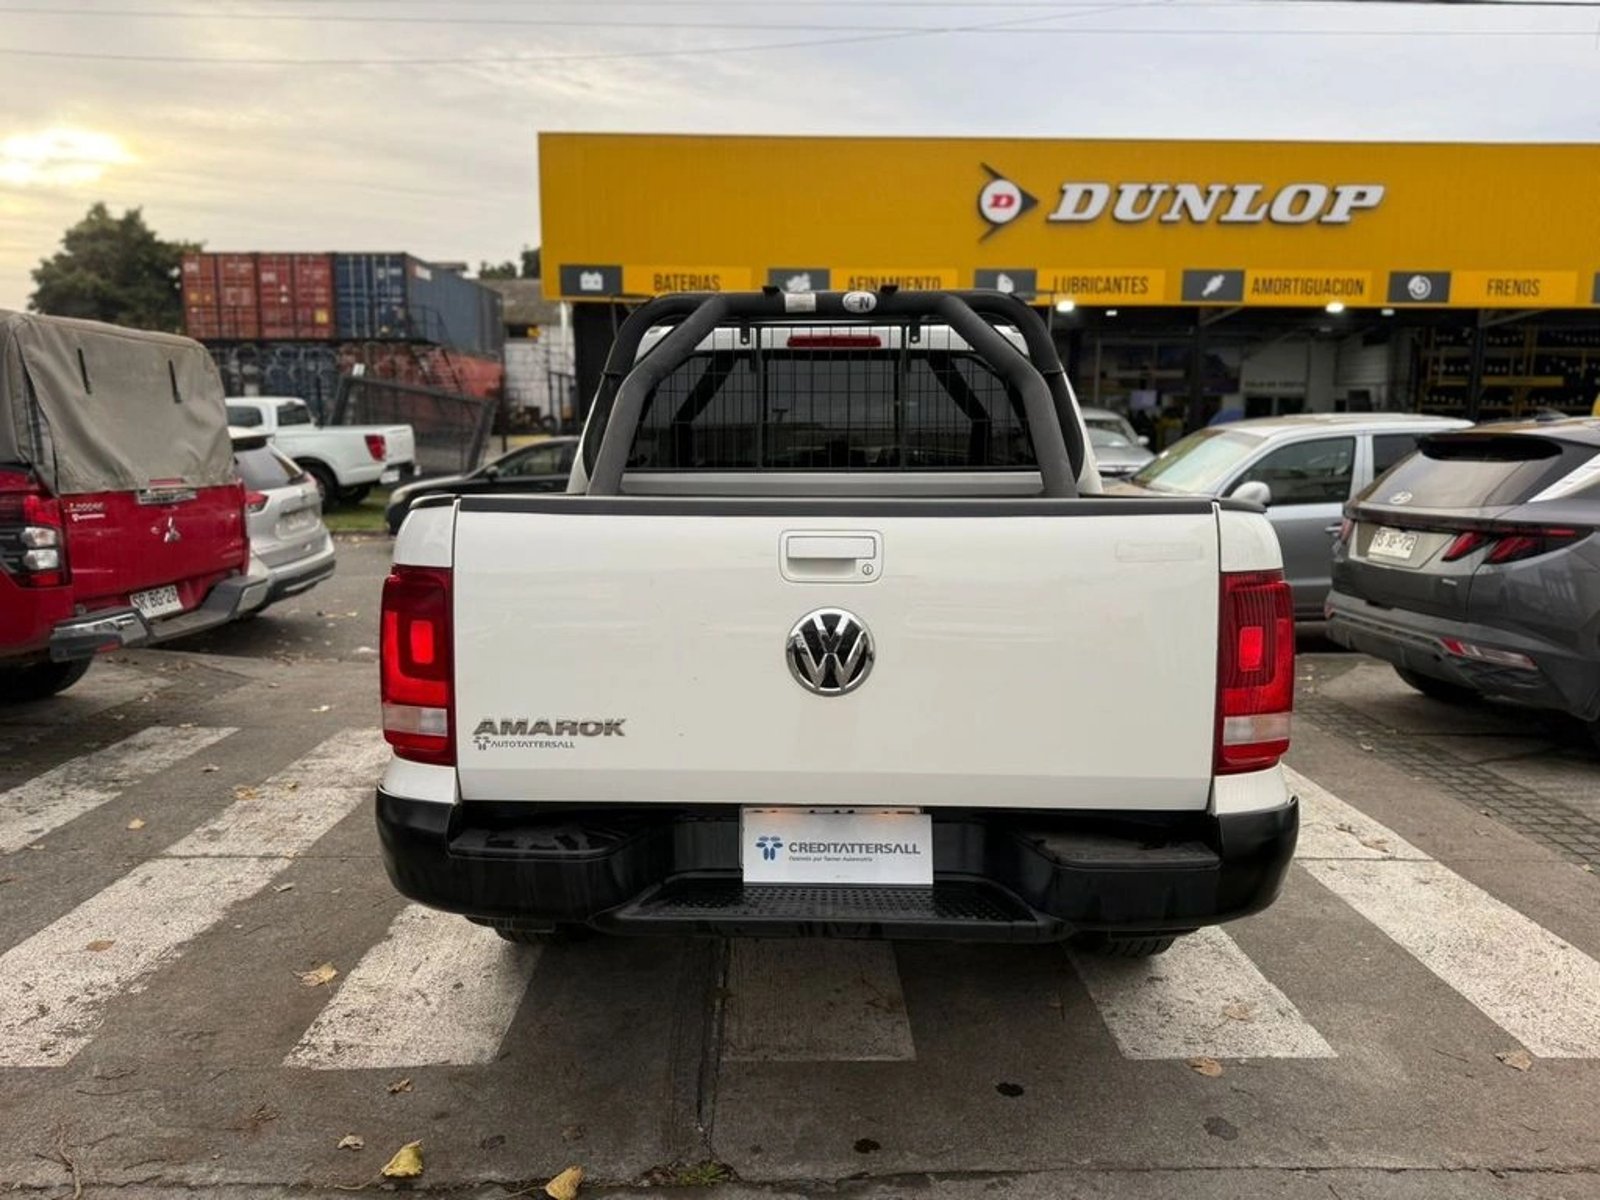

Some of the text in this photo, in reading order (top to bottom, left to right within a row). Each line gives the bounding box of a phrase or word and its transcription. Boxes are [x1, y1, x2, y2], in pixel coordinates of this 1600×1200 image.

[988, 194, 1015, 208] D
[1046, 182, 1386, 223] DUNLOP
[653, 274, 720, 291] BATERIAS
[1053, 275, 1149, 295] LUBRICANTES
[1252, 277, 1365, 297] AMORTIGUACION
[1486, 278, 1541, 297] FRENOS
[472, 719, 626, 737] AMAROK
[490, 739, 576, 749] AUTOTATTERSALL
[788, 842, 921, 855] CREDITATTERSALL
